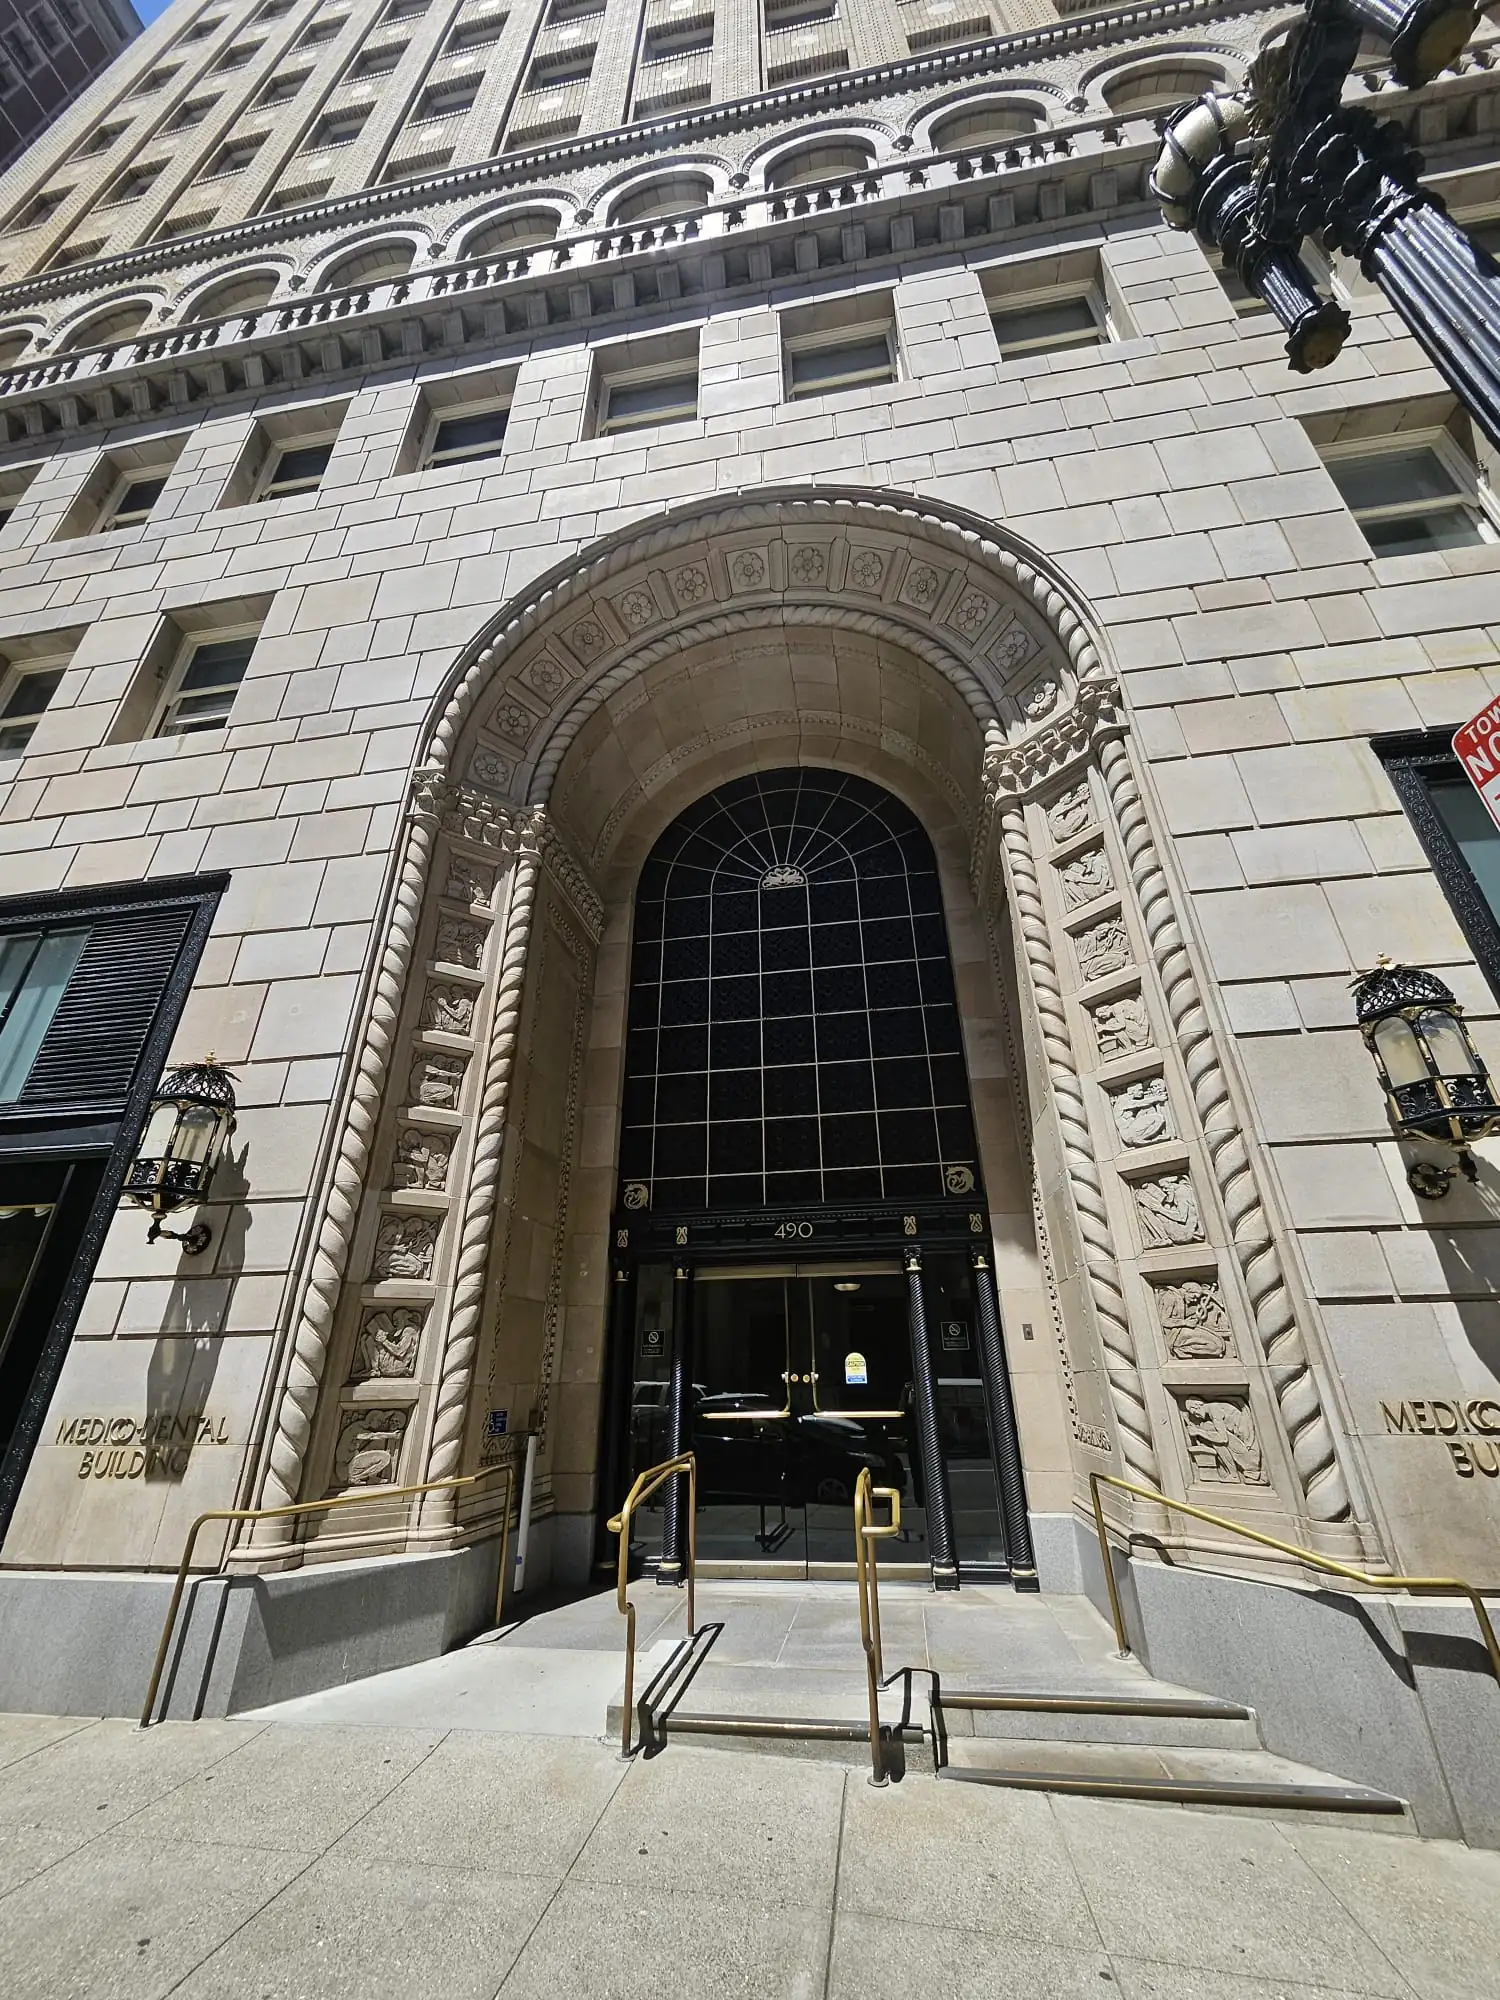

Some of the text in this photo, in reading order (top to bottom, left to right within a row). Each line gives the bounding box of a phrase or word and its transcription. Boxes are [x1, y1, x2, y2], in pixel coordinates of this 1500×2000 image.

[774, 1222, 813, 1239] 490
[56, 1416, 229, 1446] MEDICO-DENTAL
[78, 1449, 190, 1480] BUILDING
